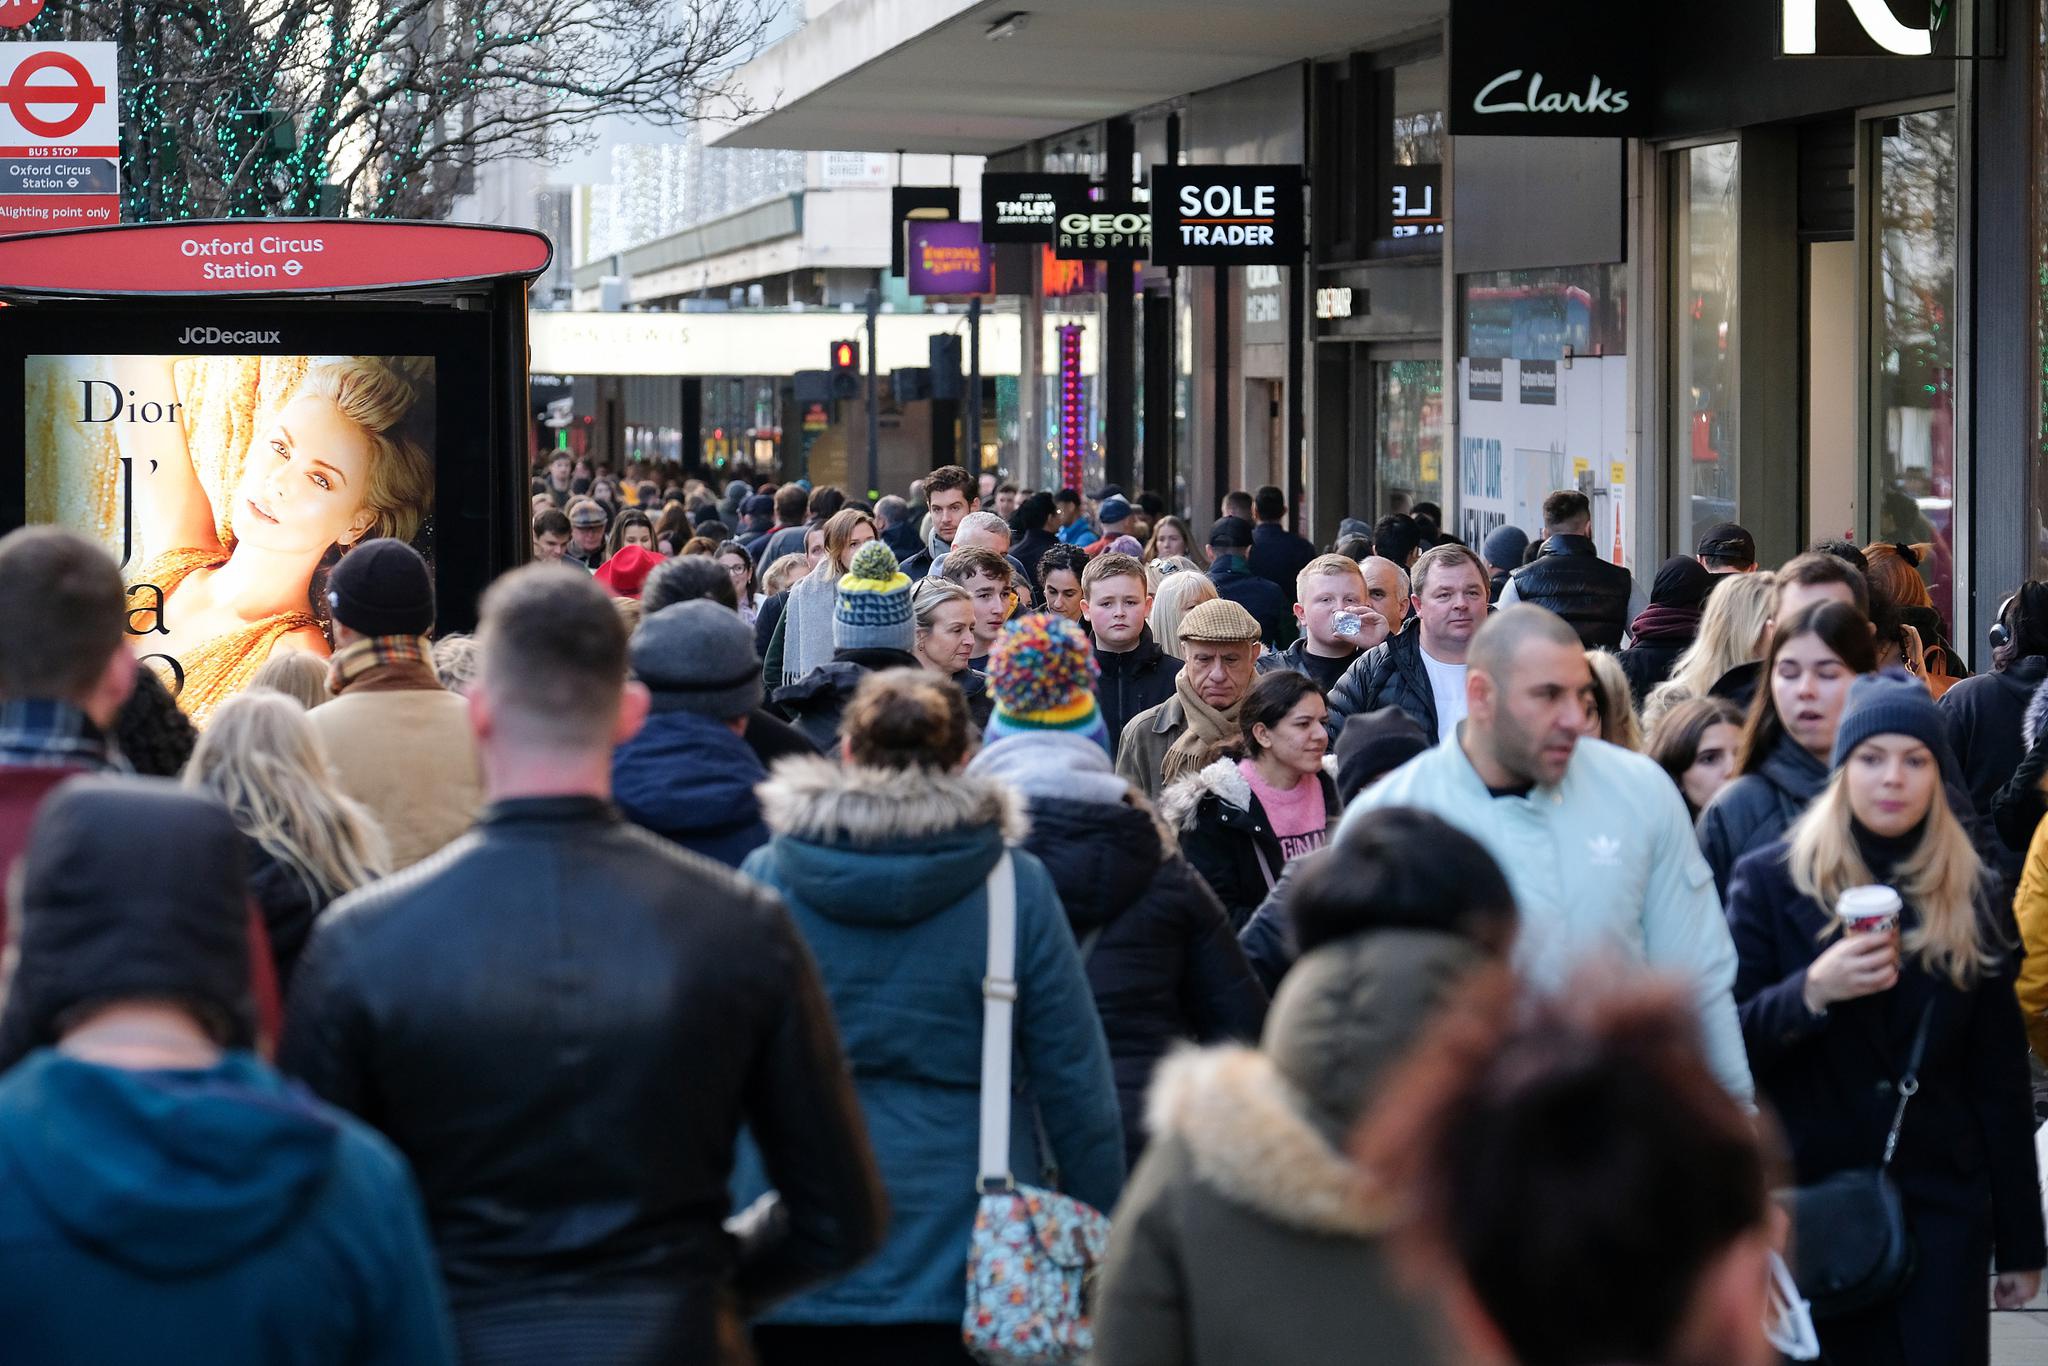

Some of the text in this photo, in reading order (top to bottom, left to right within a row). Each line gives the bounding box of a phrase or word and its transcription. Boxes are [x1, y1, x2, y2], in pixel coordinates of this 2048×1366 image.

[1473, 69, 1630, 114] Clarks
[28, 147, 79, 156] BUS STOP
[9, 165, 91, 176] Oxford Circus
[22, 178, 63, 188] Station
[1179, 185, 1275, 217] SOLE
[0, 206, 110, 220] Alighting point only
[1179, 225, 1274, 246] TRADER
[181, 237, 324, 257] Oxford Circus
[203, 262, 276, 279] Station
[178, 327, 280, 344] JCDecaux
[76, 380, 182, 423] Dior
